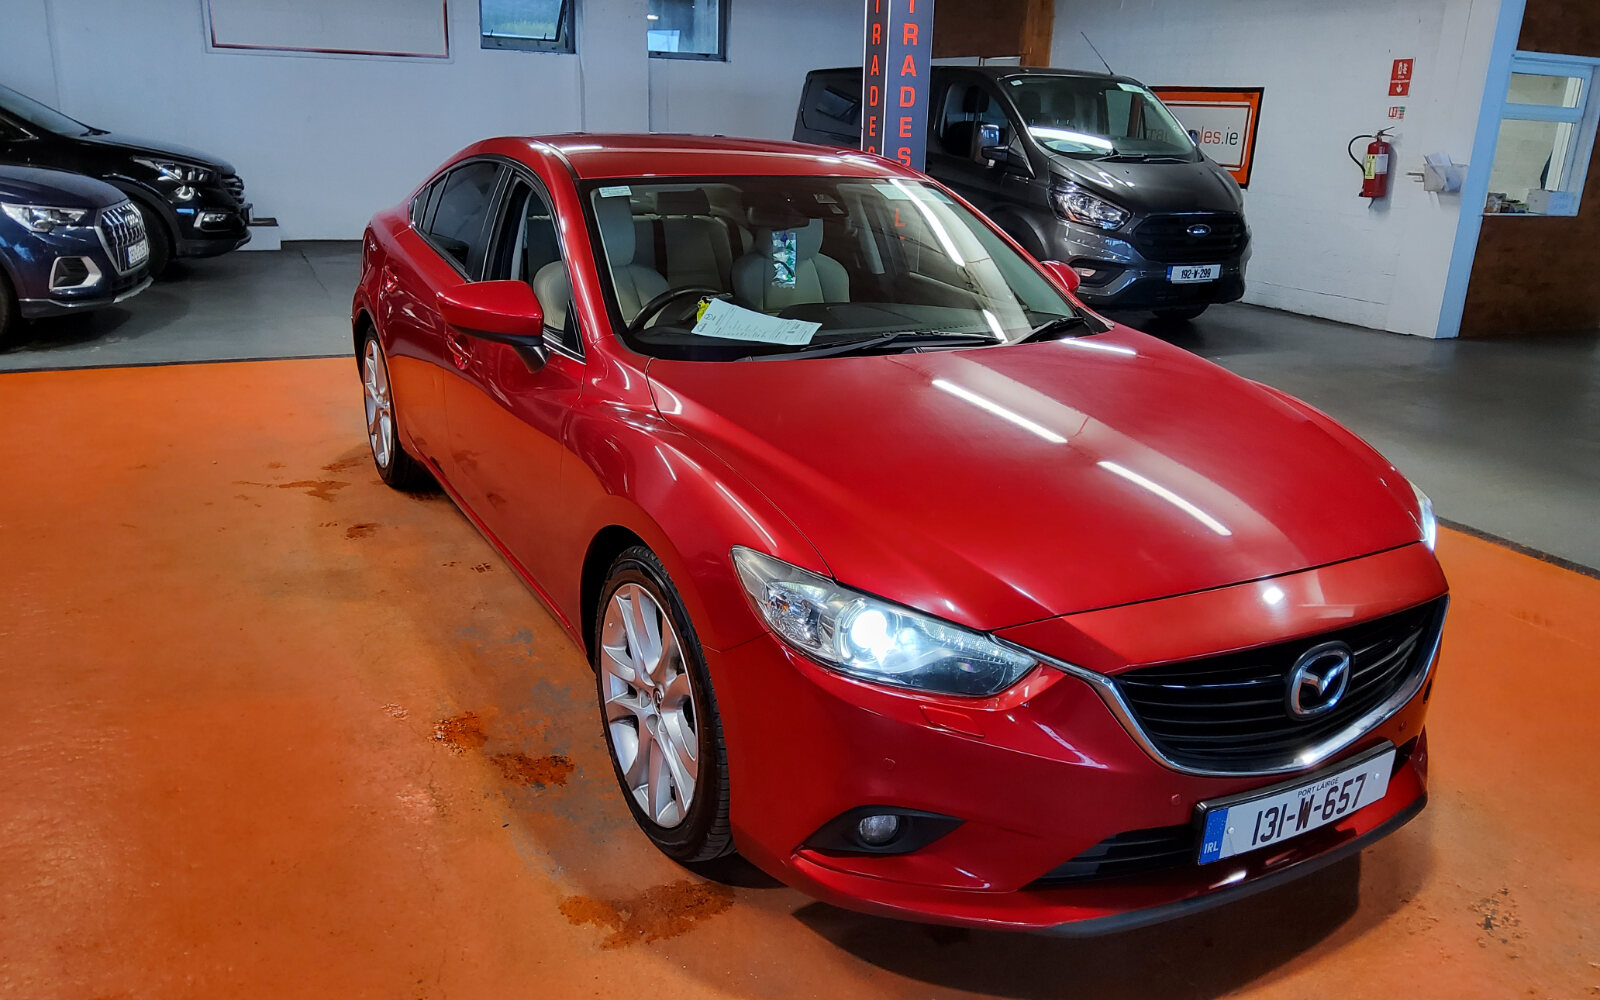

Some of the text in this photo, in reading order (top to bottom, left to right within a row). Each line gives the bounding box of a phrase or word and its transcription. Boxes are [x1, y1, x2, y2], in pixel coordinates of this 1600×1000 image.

[868, 0, 881, 152] RADE
[1199, 125, 1239, 146] les.ie
[1298, 786, 1316, 798] PORT
[1251, 772, 1368, 846] 131-W-657
[1203, 841, 1219, 855] IRL
